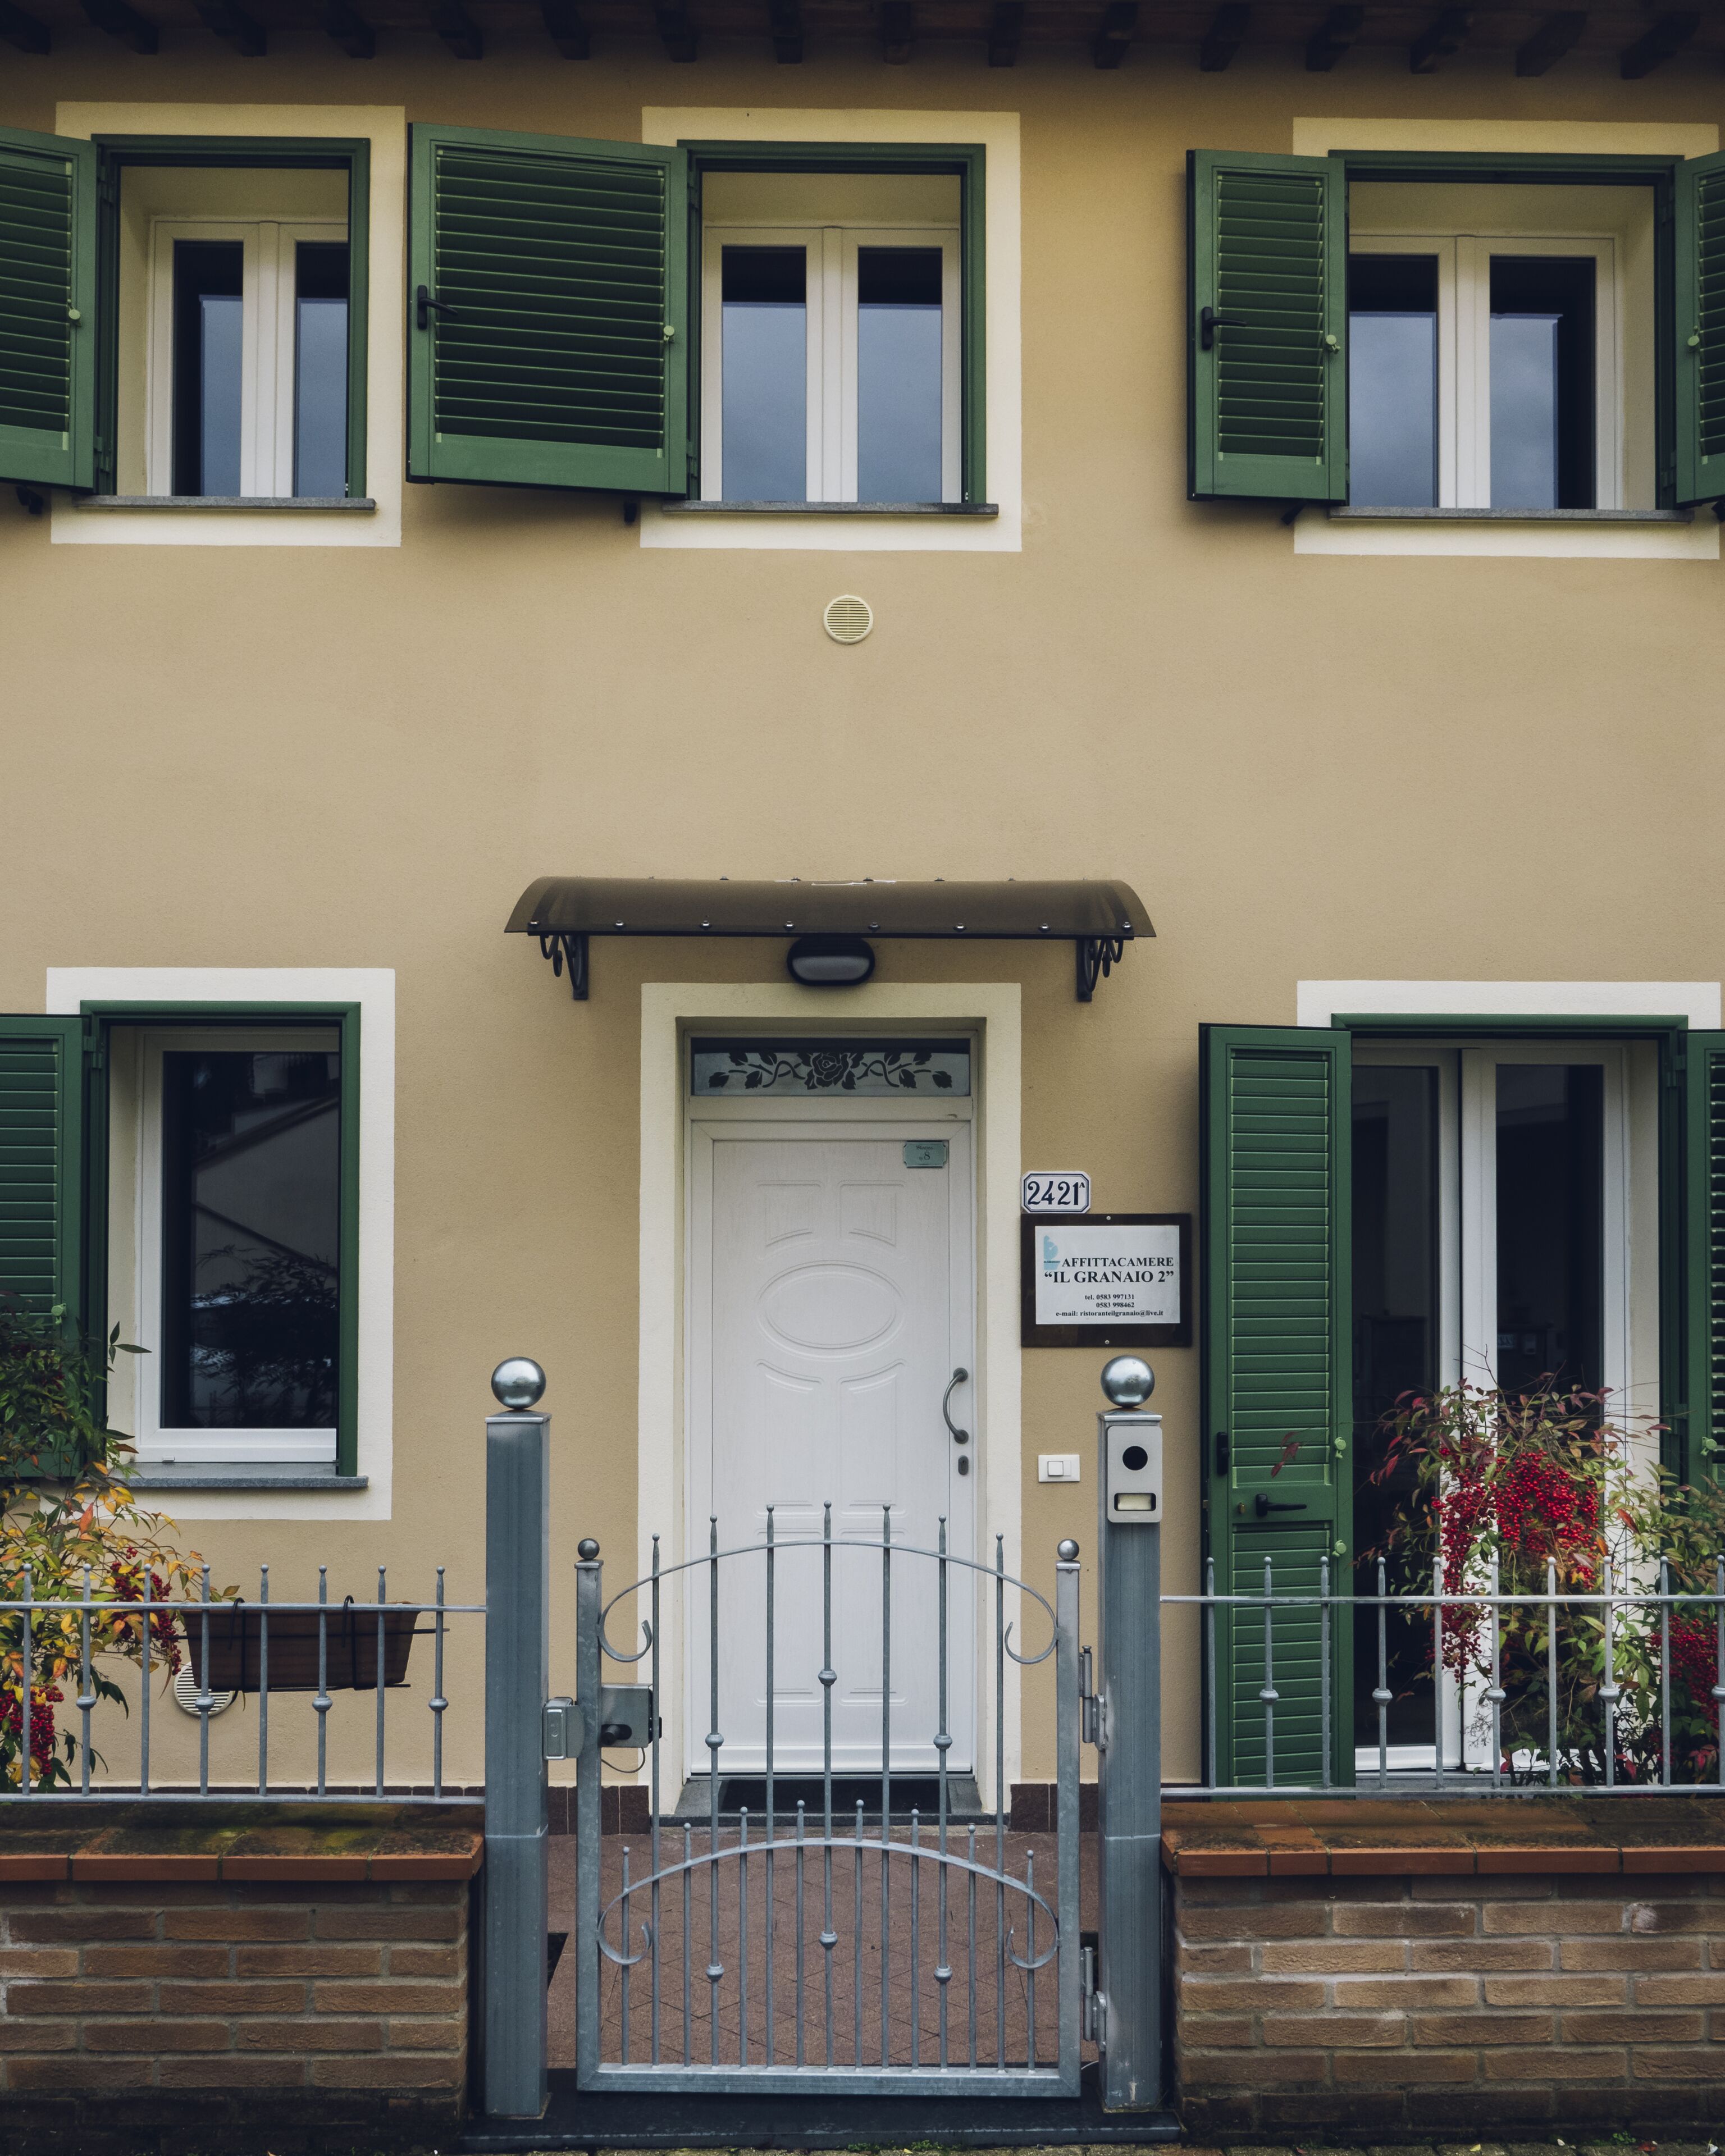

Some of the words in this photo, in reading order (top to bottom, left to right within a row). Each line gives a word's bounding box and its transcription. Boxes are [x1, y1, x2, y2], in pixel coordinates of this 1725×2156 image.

[1061, 1257, 1174, 1267] AFFITTACAMERE
[1044, 1270, 1070, 1283] “IL
[1074, 1270, 1154, 1283] GRANAIO
[1157, 1270, 1174, 1283] 2”
[1080, 1309, 1163, 1318] ristoranteilgranaio@live.it
